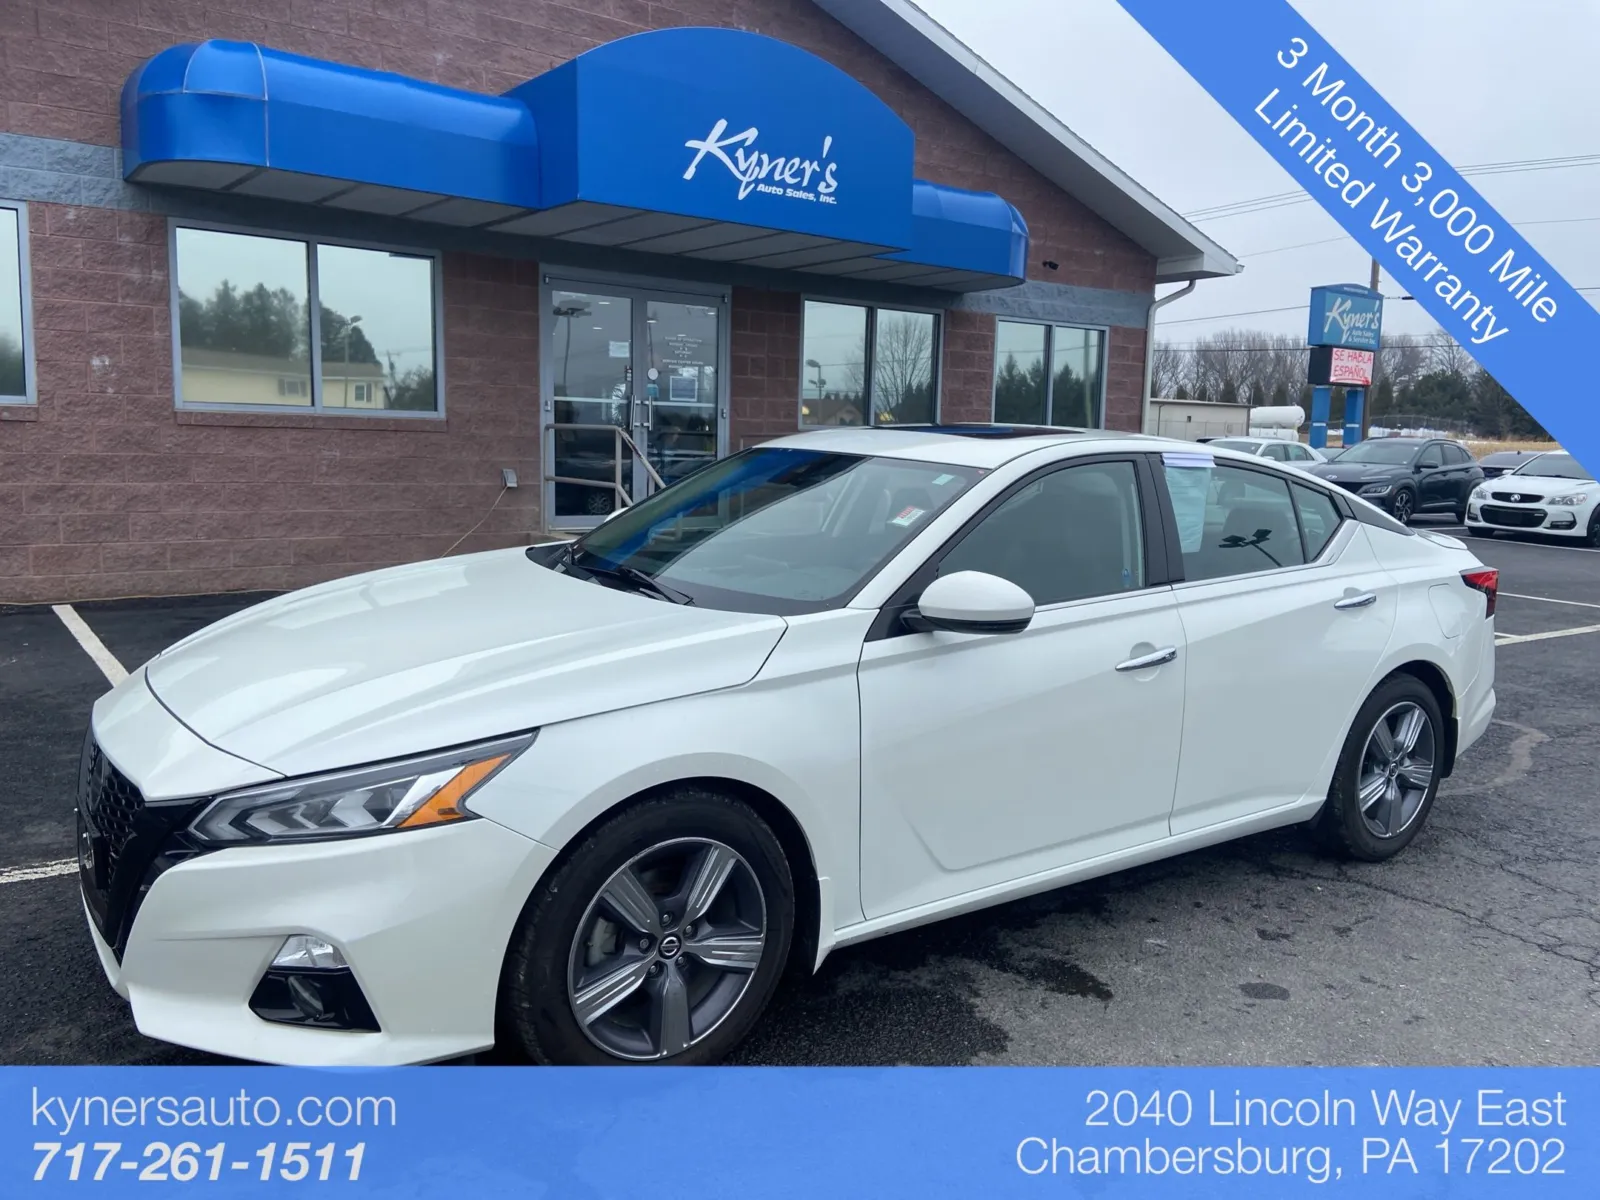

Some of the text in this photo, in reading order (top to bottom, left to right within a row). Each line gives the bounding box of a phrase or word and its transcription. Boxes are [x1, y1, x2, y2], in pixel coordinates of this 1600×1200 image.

[683, 118, 838, 200] Kyner's
[756, 183, 838, 205] Auto Sales, Inc.
[1324, 297, 1380, 344] Kyner's
[1334, 350, 1372, 364] SE HABLA
[1334, 365, 1367, 378] ESPAÑOL
